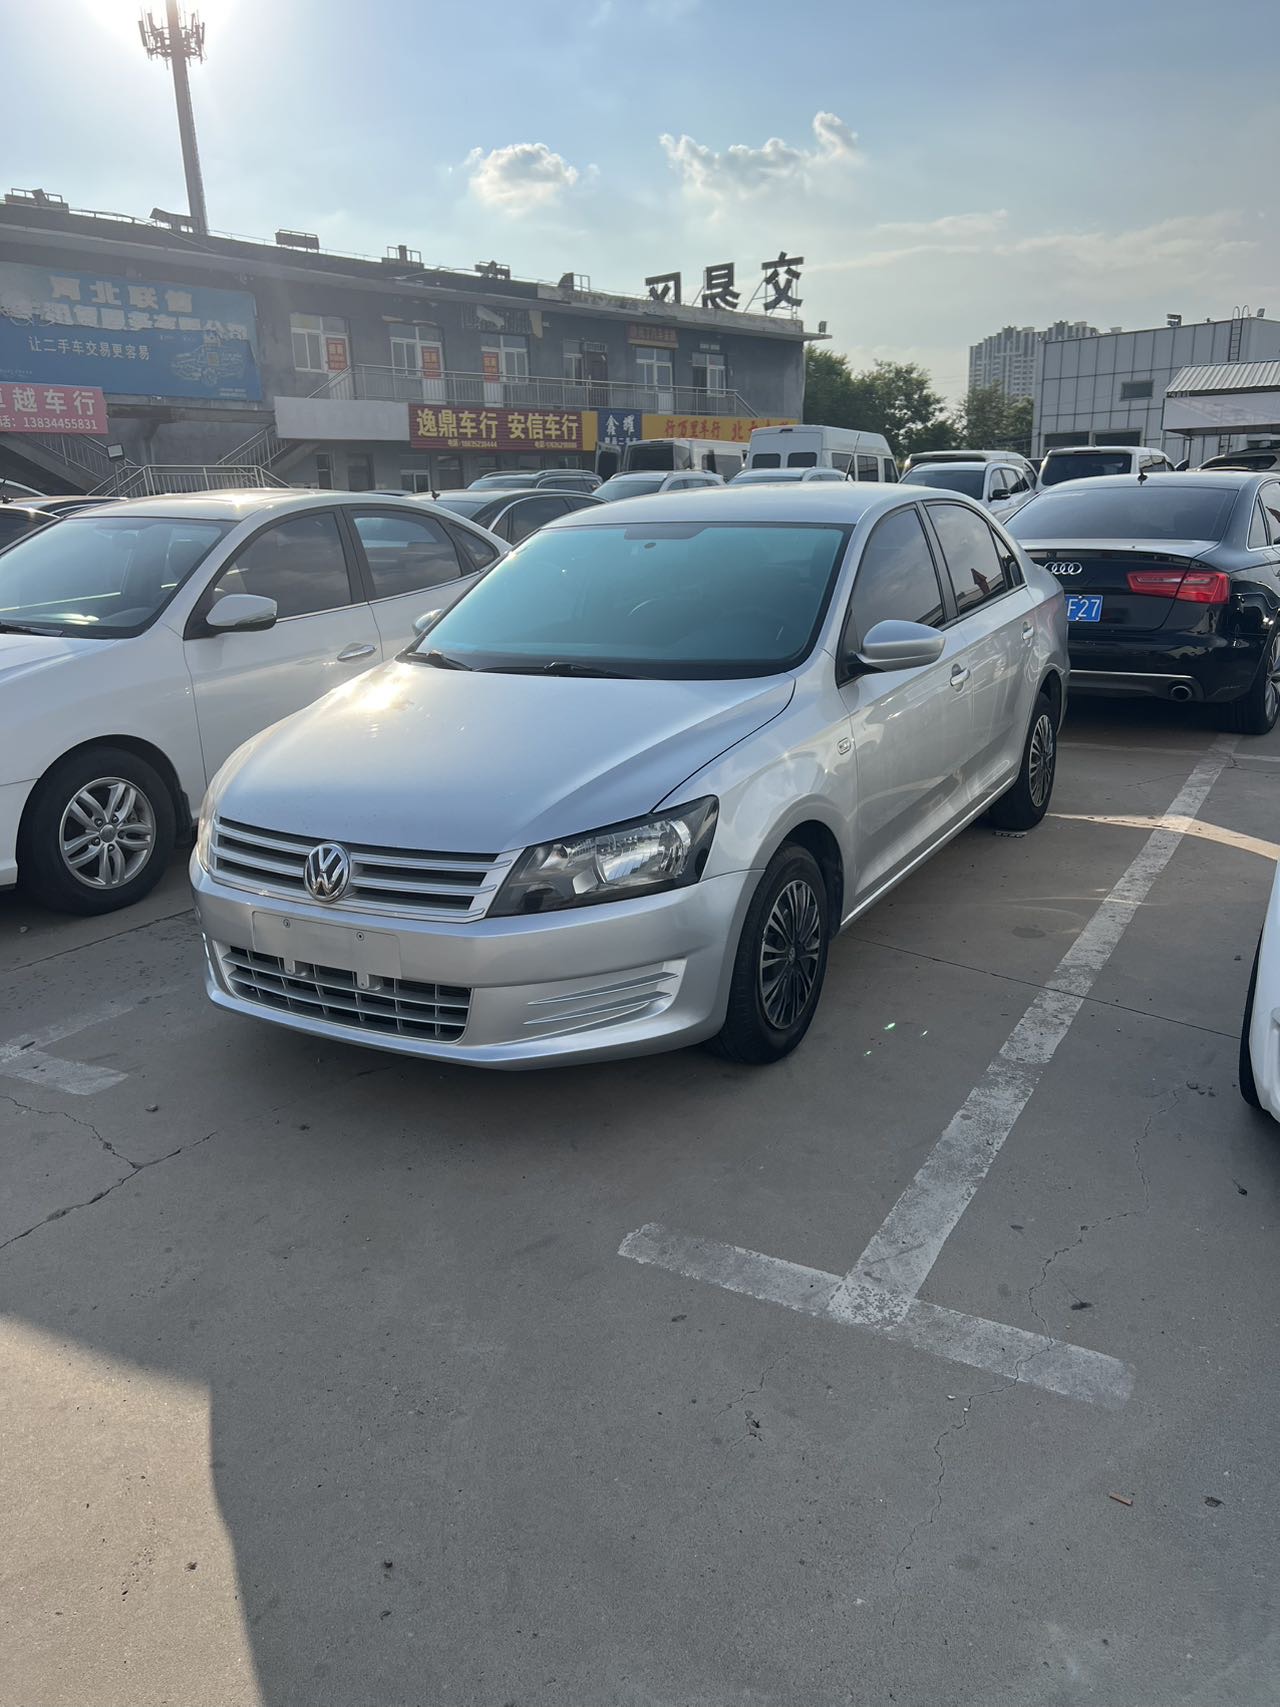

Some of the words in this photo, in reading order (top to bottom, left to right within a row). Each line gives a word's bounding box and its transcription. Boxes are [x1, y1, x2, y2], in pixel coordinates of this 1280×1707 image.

[28, 335, 150, 361] 让二手车交易更容易
[24, 417, 98, 430] 13834455831
[417, 408, 498, 439] 逸鼎车行
[508, 412, 578, 440] 安信车行
[1067, 599, 1100, 617] F27
